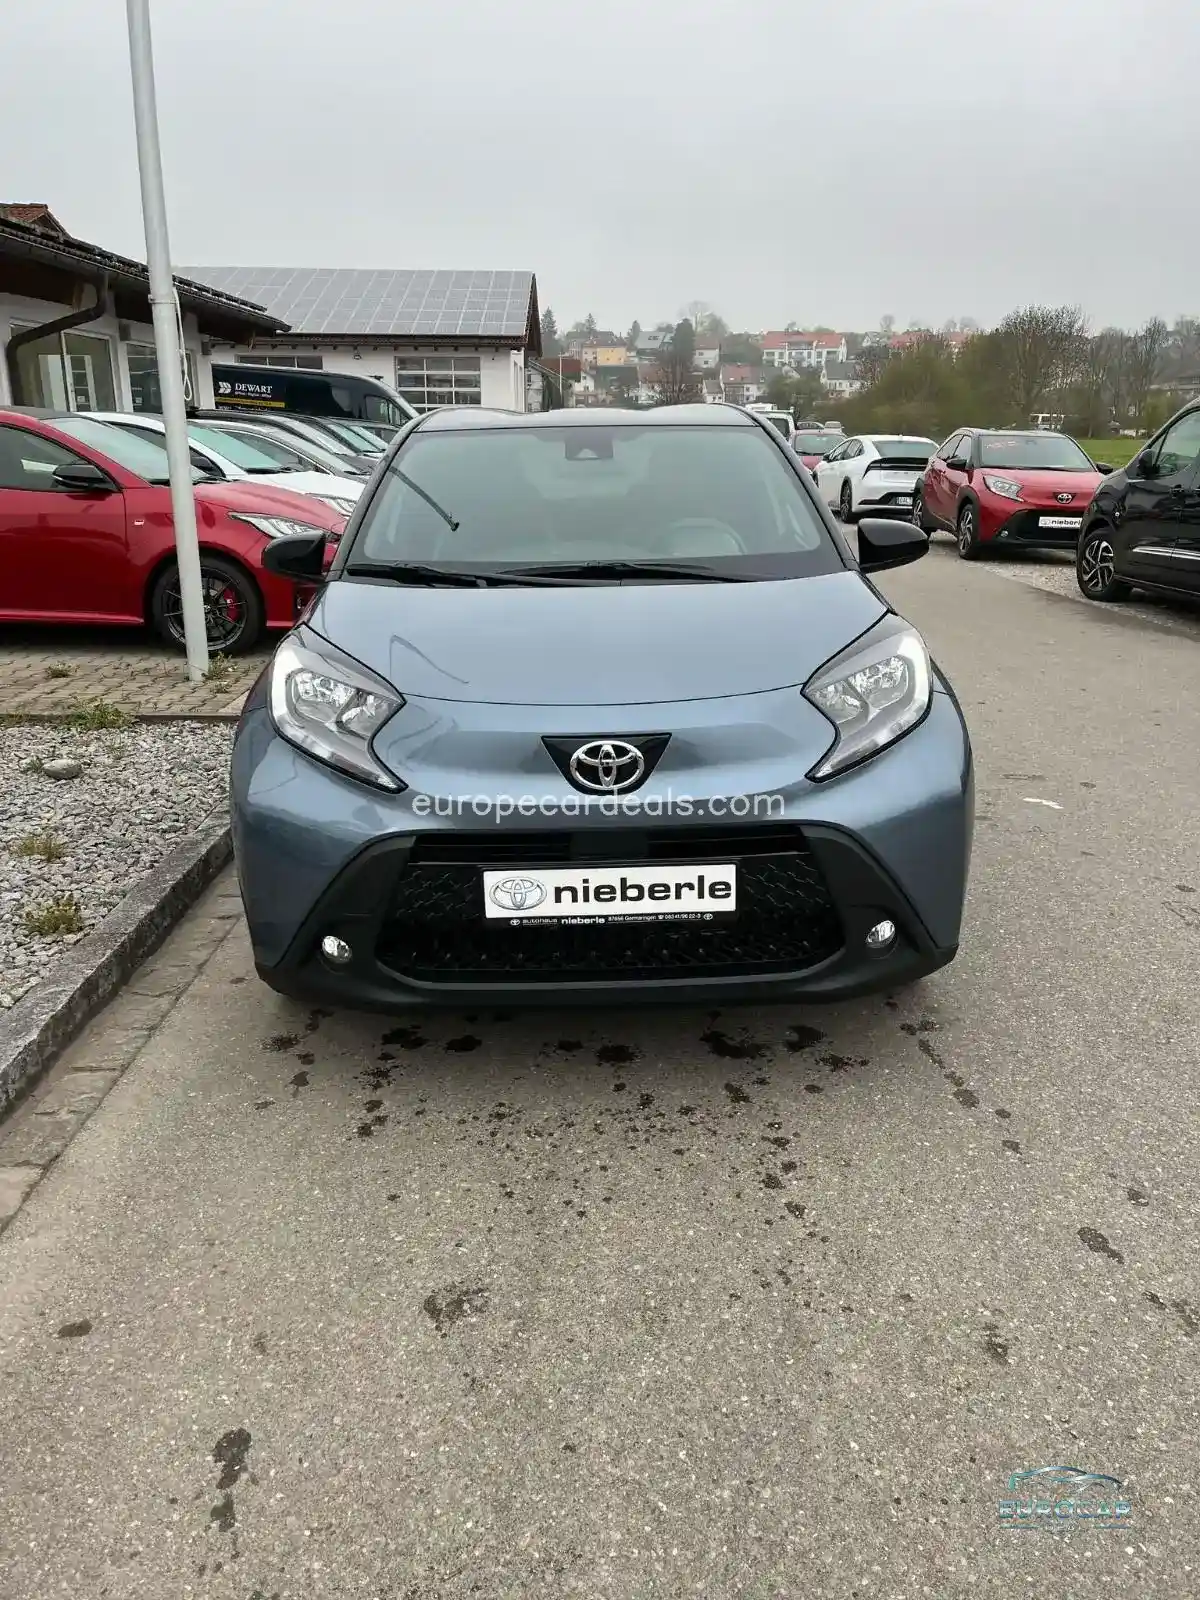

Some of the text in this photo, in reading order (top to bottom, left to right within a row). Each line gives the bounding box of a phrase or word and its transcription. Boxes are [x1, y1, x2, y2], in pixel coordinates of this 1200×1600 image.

[234, 382, 273, 393] DEWART
[554, 875, 732, 904] nieberle
[561, 916, 606, 925] nieberle
